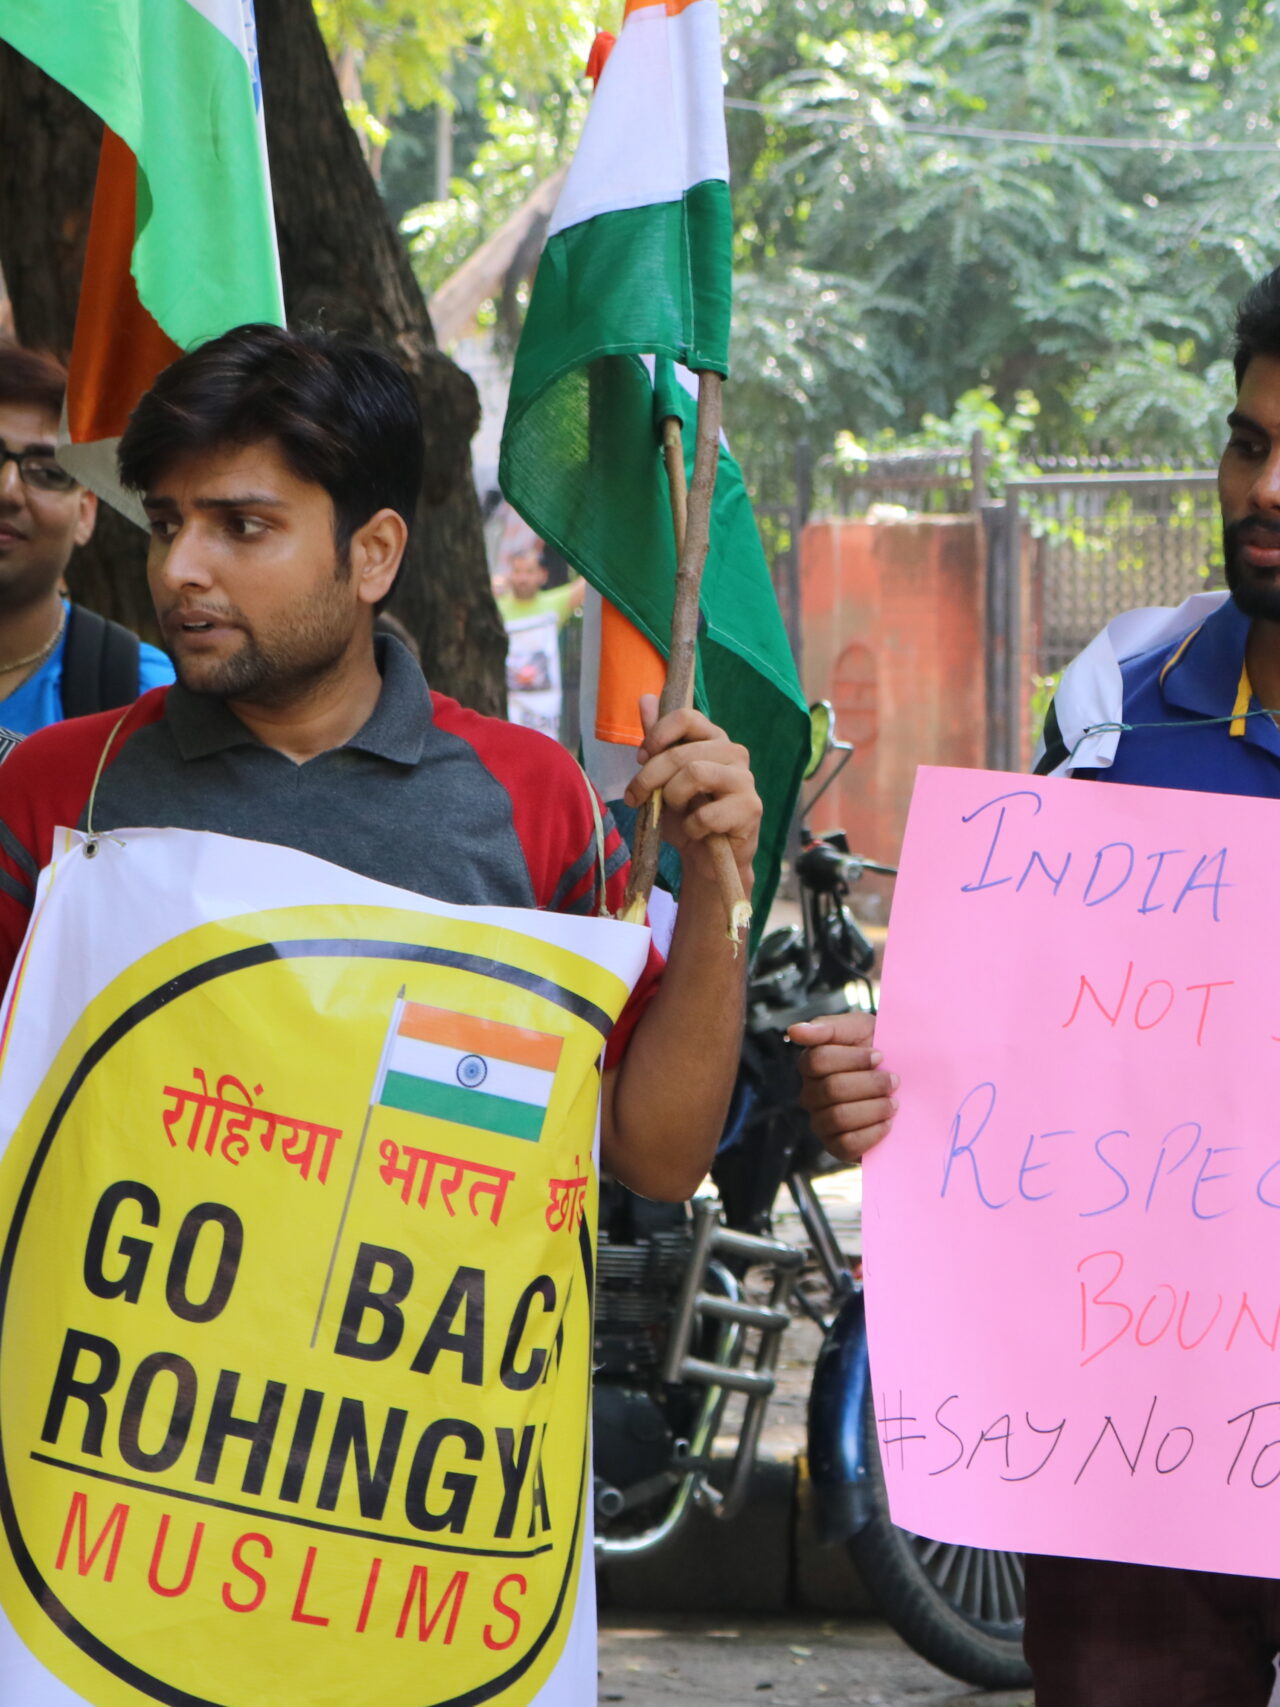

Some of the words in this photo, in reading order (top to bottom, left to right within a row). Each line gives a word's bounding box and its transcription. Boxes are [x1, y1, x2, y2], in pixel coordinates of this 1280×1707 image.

[961, 791, 1236, 922] INDIA
[1062, 961, 1235, 1046] NOT
[162, 1067, 343, 1186] रोहिंग्या
[378, 1139, 516, 1227] भारत
[84, 1180, 244, 1324] GO
[334, 1243, 573, 1391] BAC
[1074, 1396, 1194, 1485] NO
[55, 1491, 527, 1651] MUSLIMS
